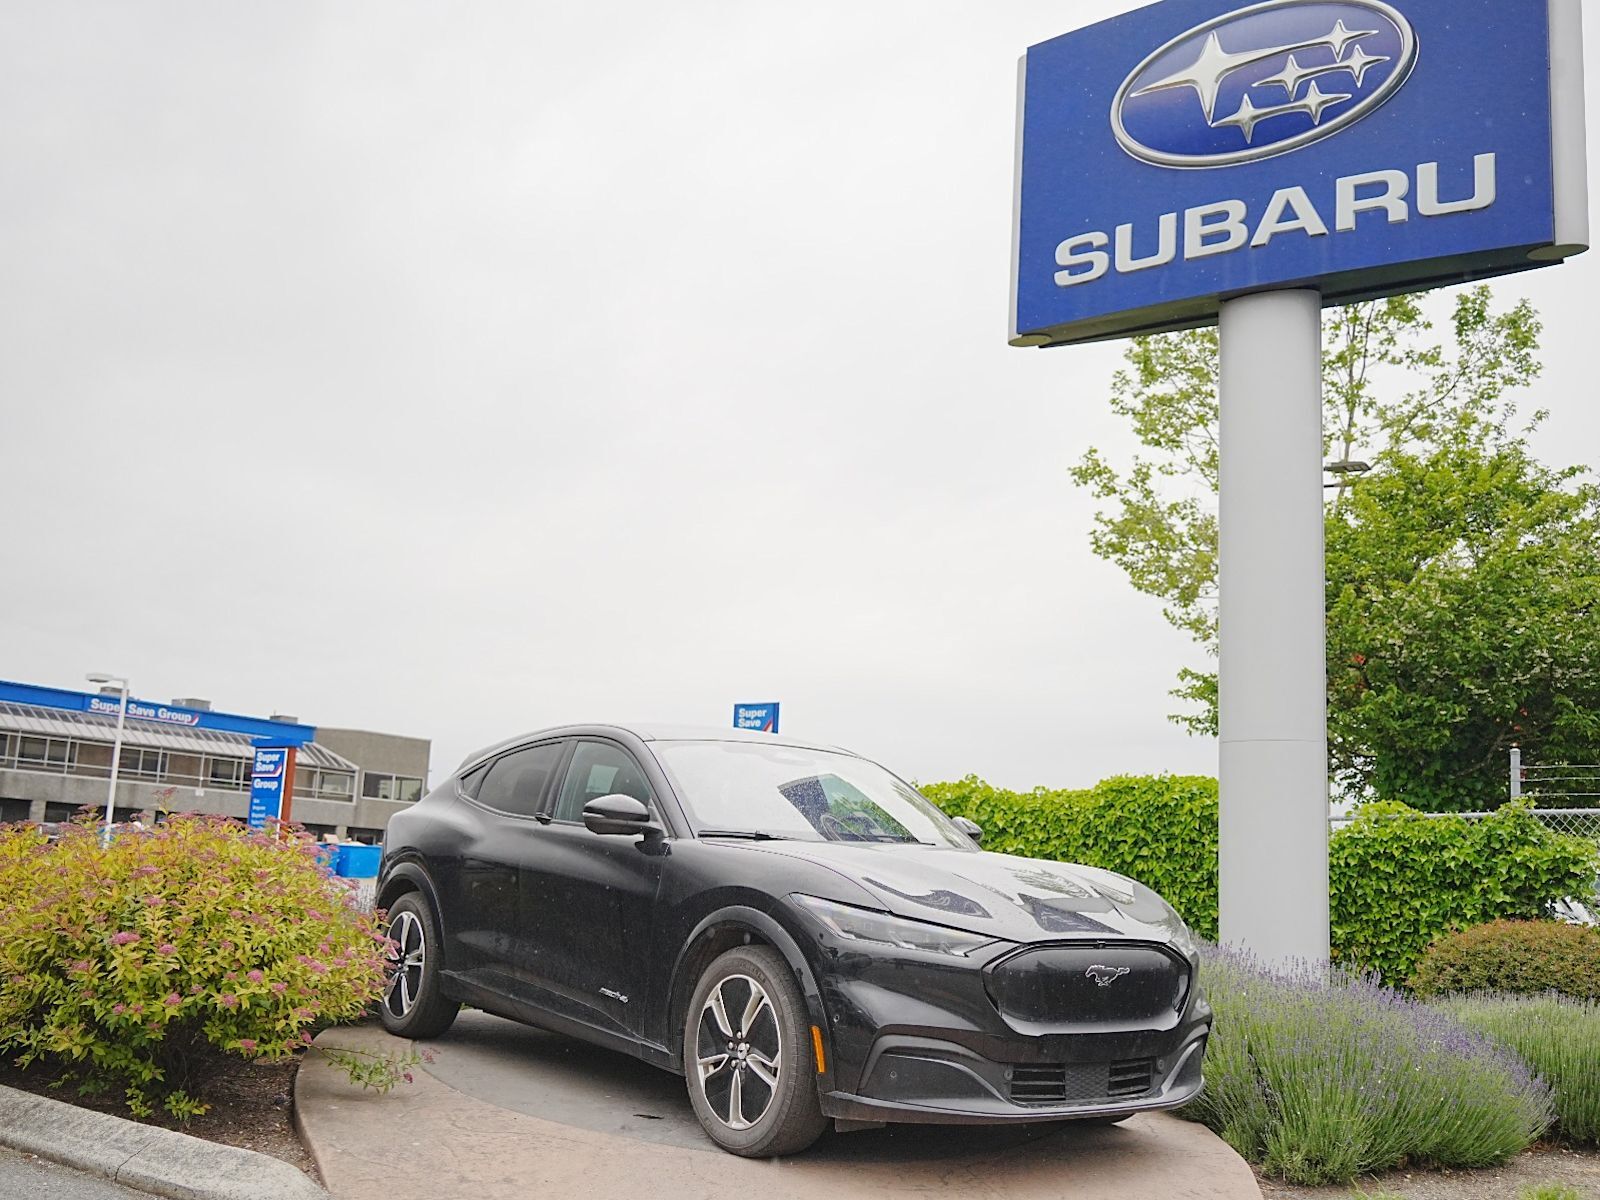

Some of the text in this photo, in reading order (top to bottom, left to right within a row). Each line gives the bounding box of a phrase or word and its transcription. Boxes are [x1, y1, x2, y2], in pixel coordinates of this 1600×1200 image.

[1054, 152, 1496, 286] SUBARU
[90, 698, 192, 724] Supe Save Group
[739, 708, 767, 719] Super
[738, 718, 761, 728] Save
[257, 752, 280, 763] Super
[255, 762, 275, 772] Save
[253, 778, 278, 790] Group
